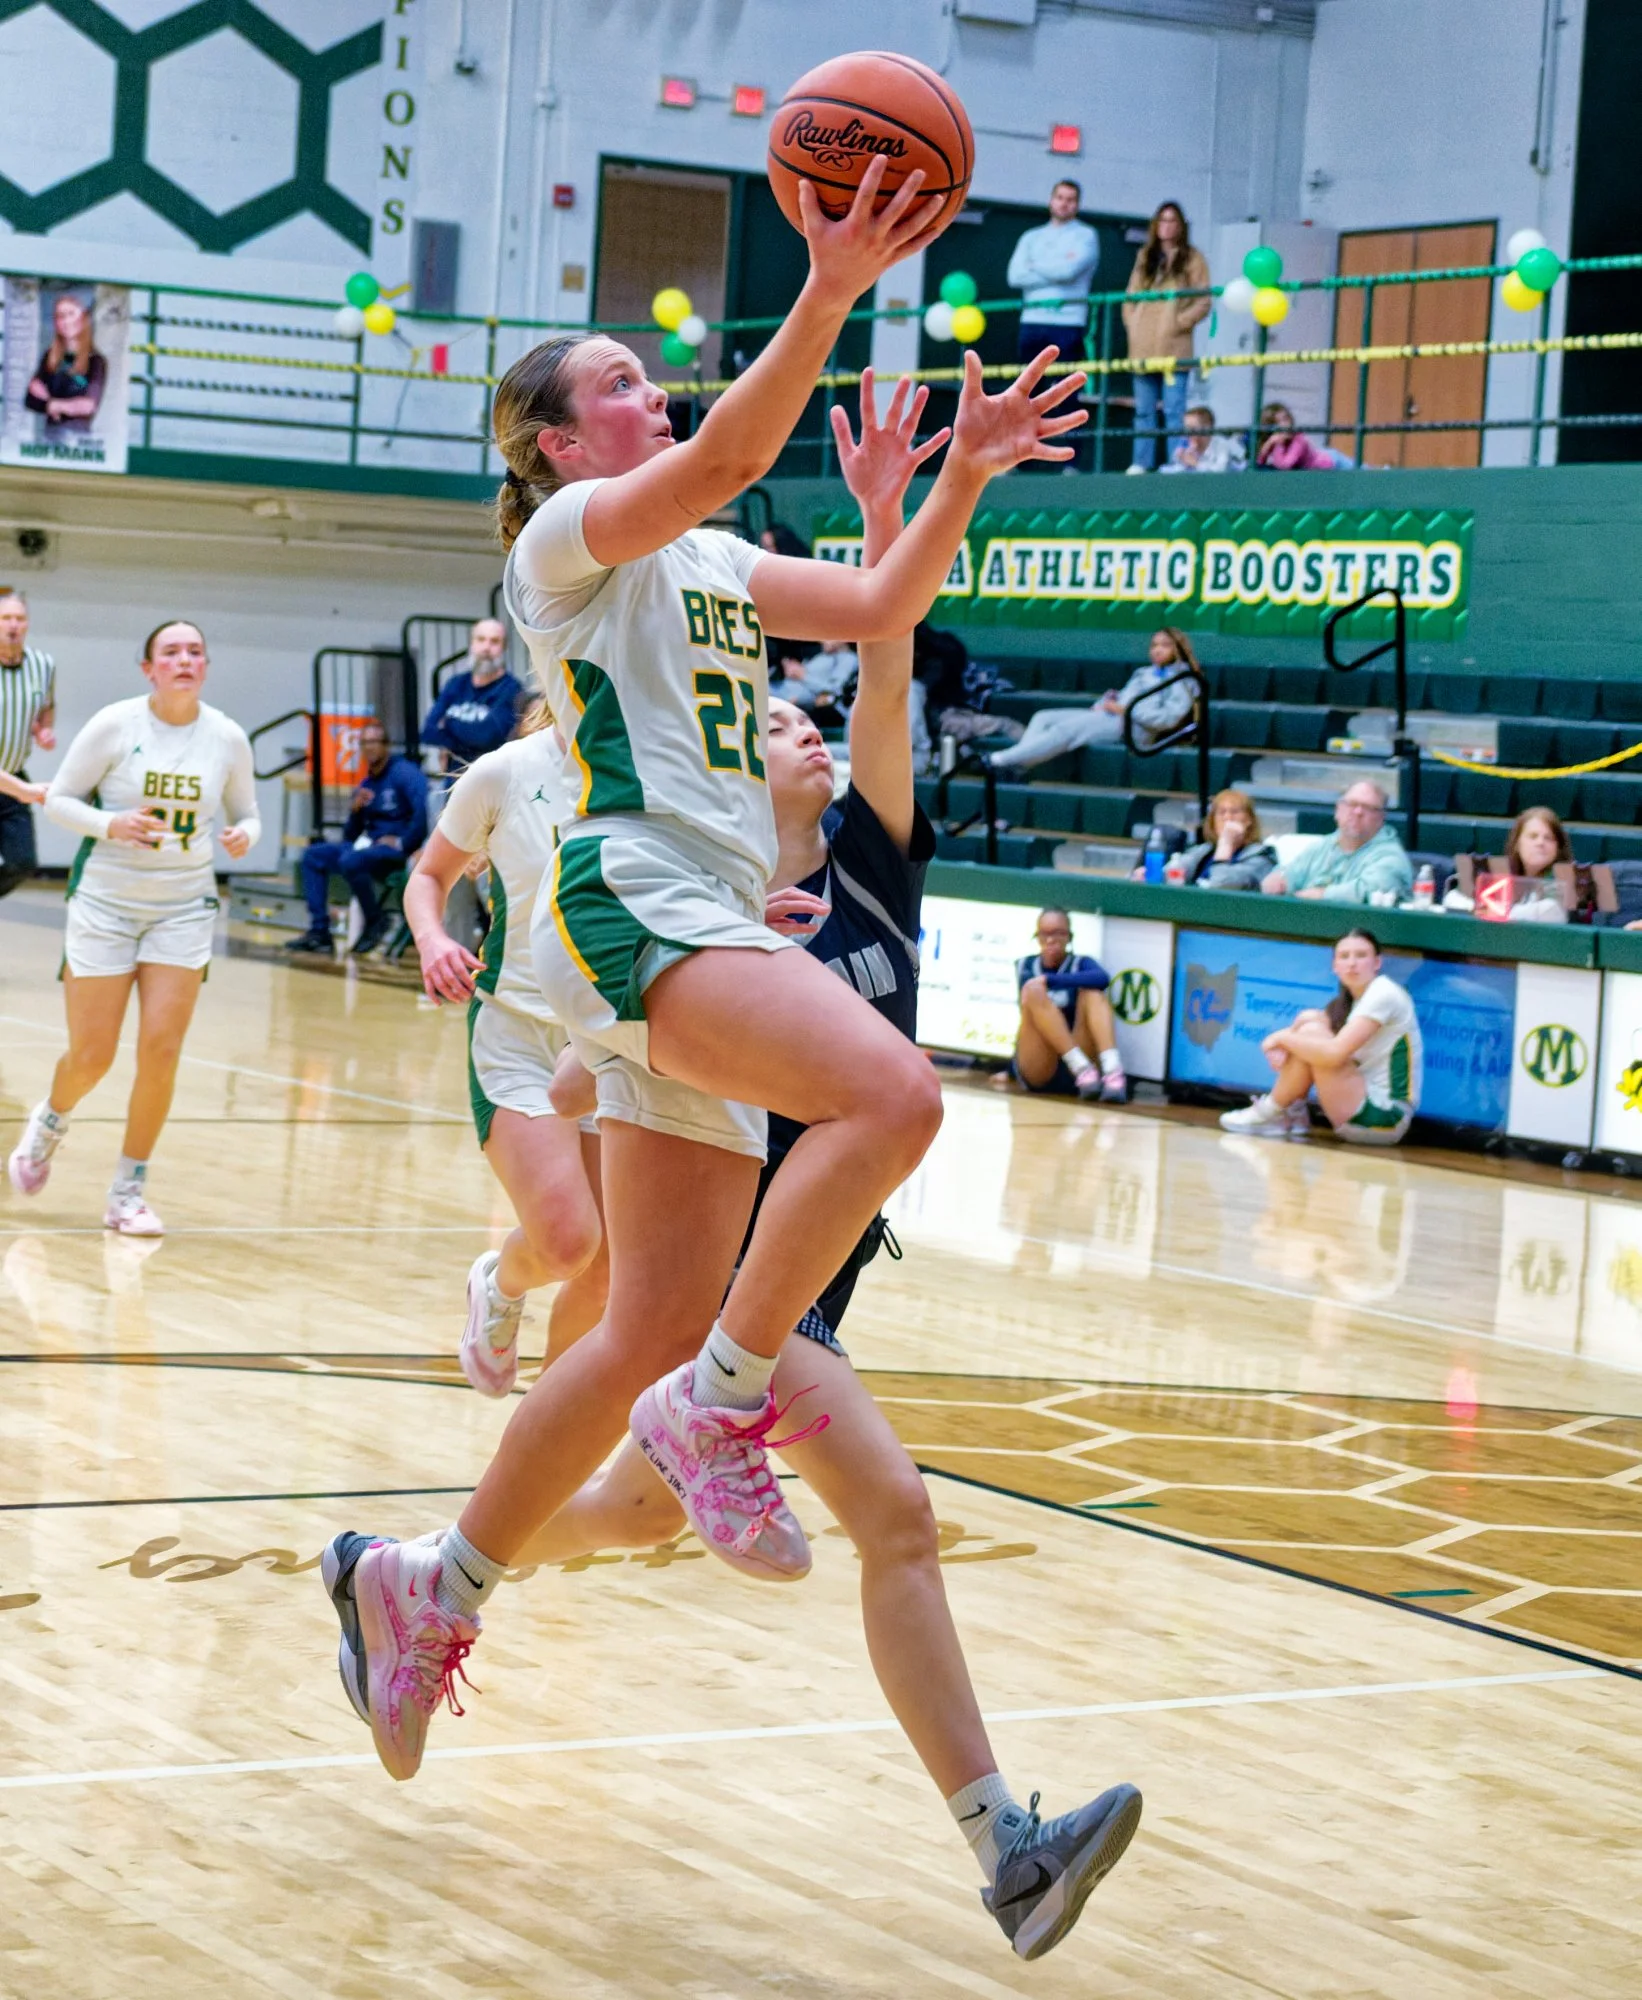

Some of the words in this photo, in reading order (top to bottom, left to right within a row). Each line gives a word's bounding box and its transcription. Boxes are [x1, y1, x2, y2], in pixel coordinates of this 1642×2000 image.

[783, 110, 908, 159] Rawlings
[986, 547, 1189, 591] ATHLETIC
[1209, 550, 1453, 596] BOOSTERS
[680, 587, 763, 661] BEES
[691, 669, 766, 785] 22
[143, 770, 201, 801] BEES
[1113, 970, 1157, 1024] M
[1528, 1026, 1580, 1086] M
